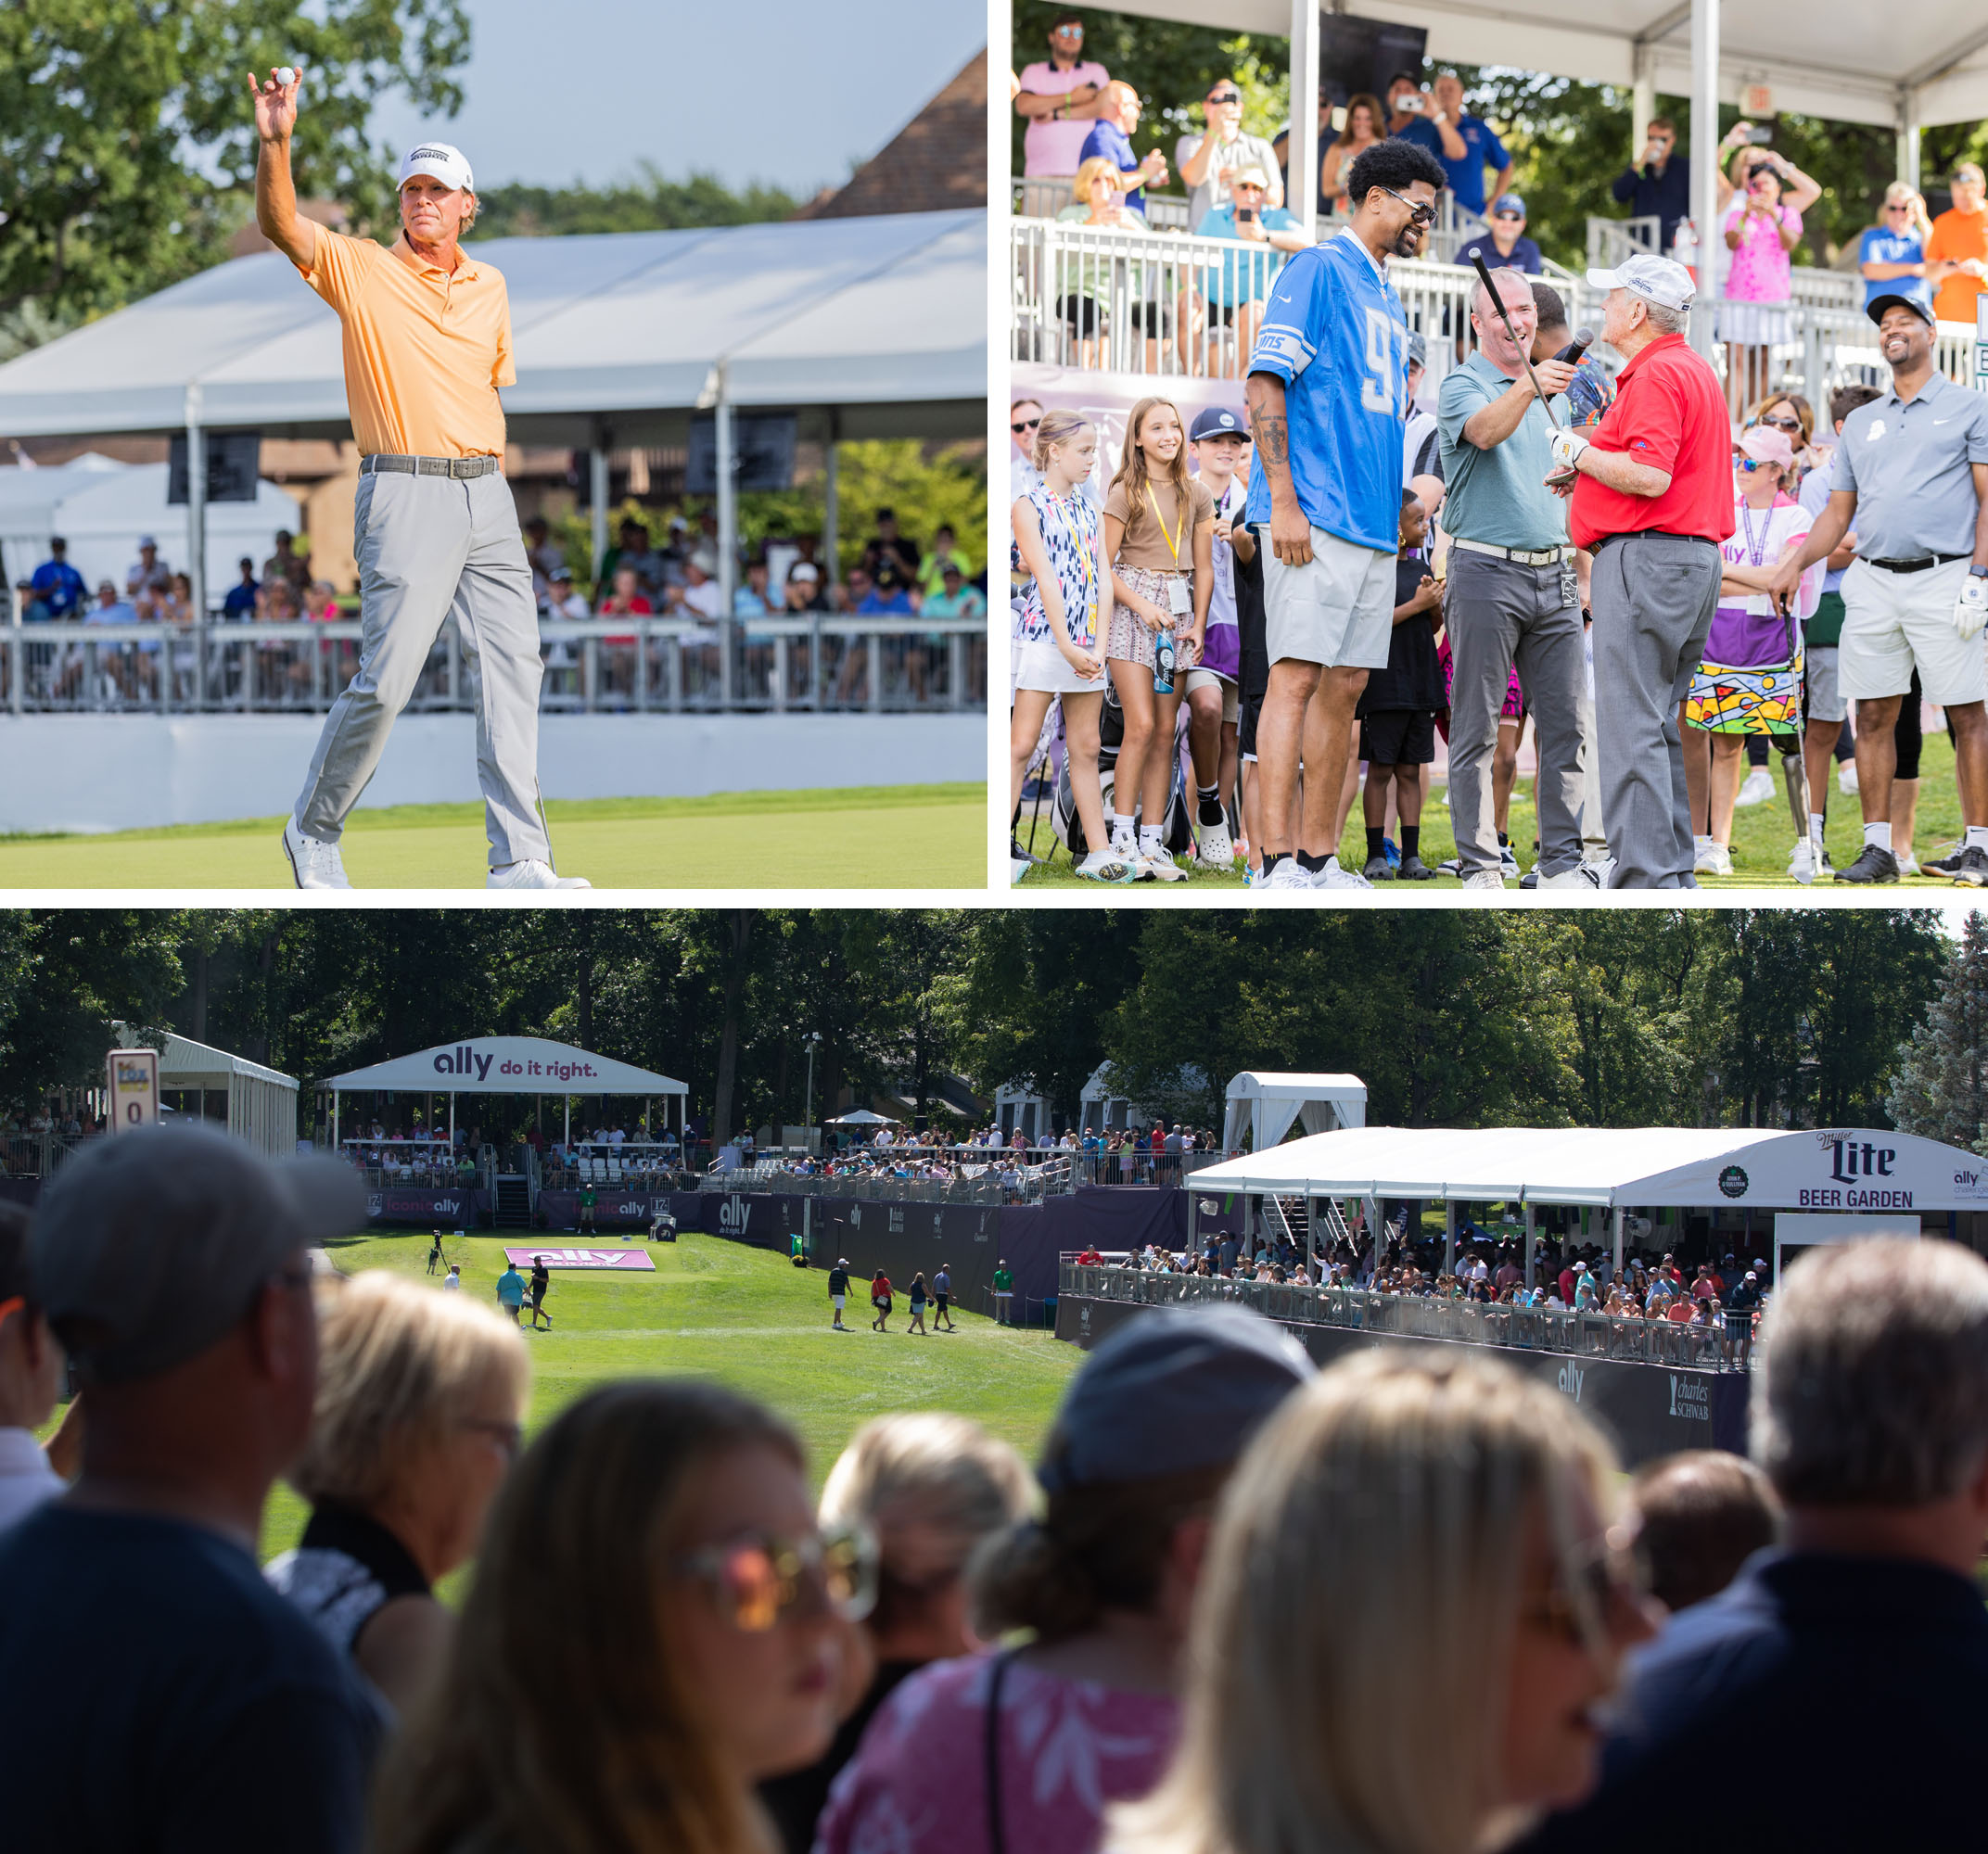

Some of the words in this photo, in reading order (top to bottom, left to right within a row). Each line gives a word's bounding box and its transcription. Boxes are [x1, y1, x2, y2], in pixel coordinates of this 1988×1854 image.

[1725, 544, 1746, 565] lly
[433, 1046, 494, 1082] ally
[500, 1060, 523, 1076] do
[528, 1060, 542, 1076] it
[546, 1061, 598, 1082] right.
[1816, 1130, 1854, 1149] Miller
[1829, 1139, 1896, 1185] Lite
[1954, 1170, 1979, 1187] ally
[1799, 1189, 1841, 1207] BEER
[1846, 1190, 1913, 1208] GARDEN
[720, 1194, 751, 1235] ally
[527, 1249, 627, 1264] ally
[1558, 1360, 1584, 1403] ally
[1677, 1375, 1708, 1403] charles
[1677, 1402, 1709, 1421] SCHWAB
